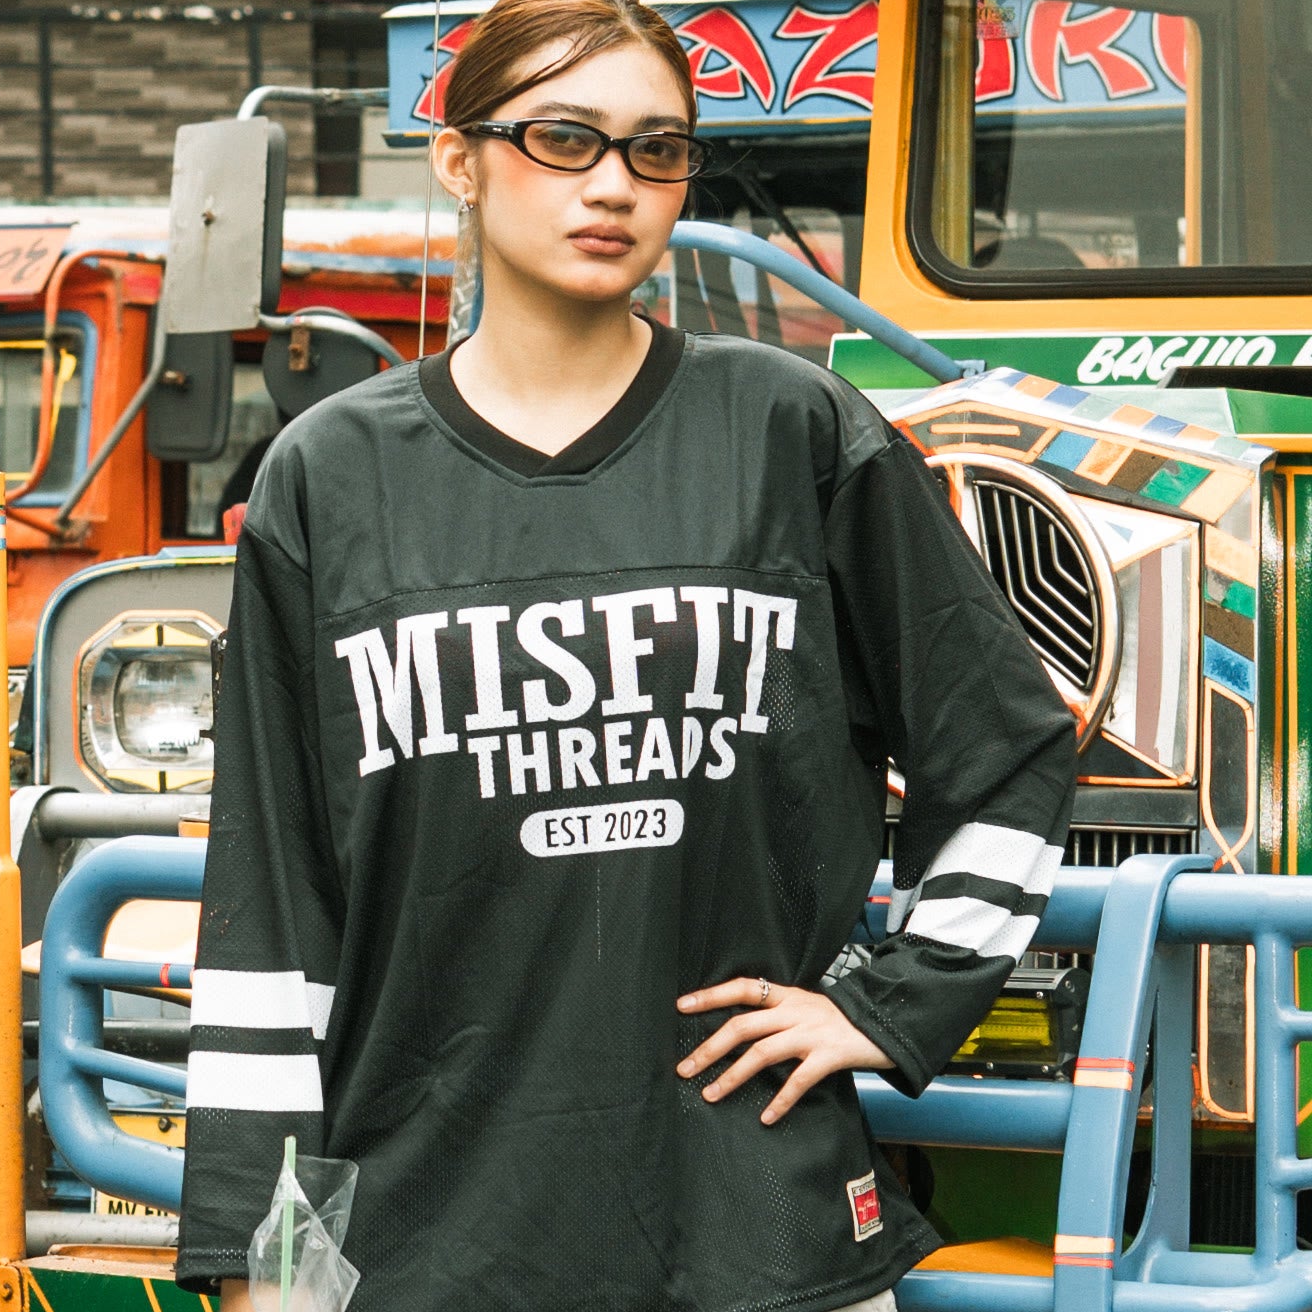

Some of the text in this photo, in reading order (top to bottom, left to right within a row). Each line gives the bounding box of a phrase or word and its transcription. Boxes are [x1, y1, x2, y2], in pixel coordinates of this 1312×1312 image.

[334, 586, 799, 778] MISFIT
[467, 716, 739, 799] THREADS
[544, 807, 667, 849] EST 2023
